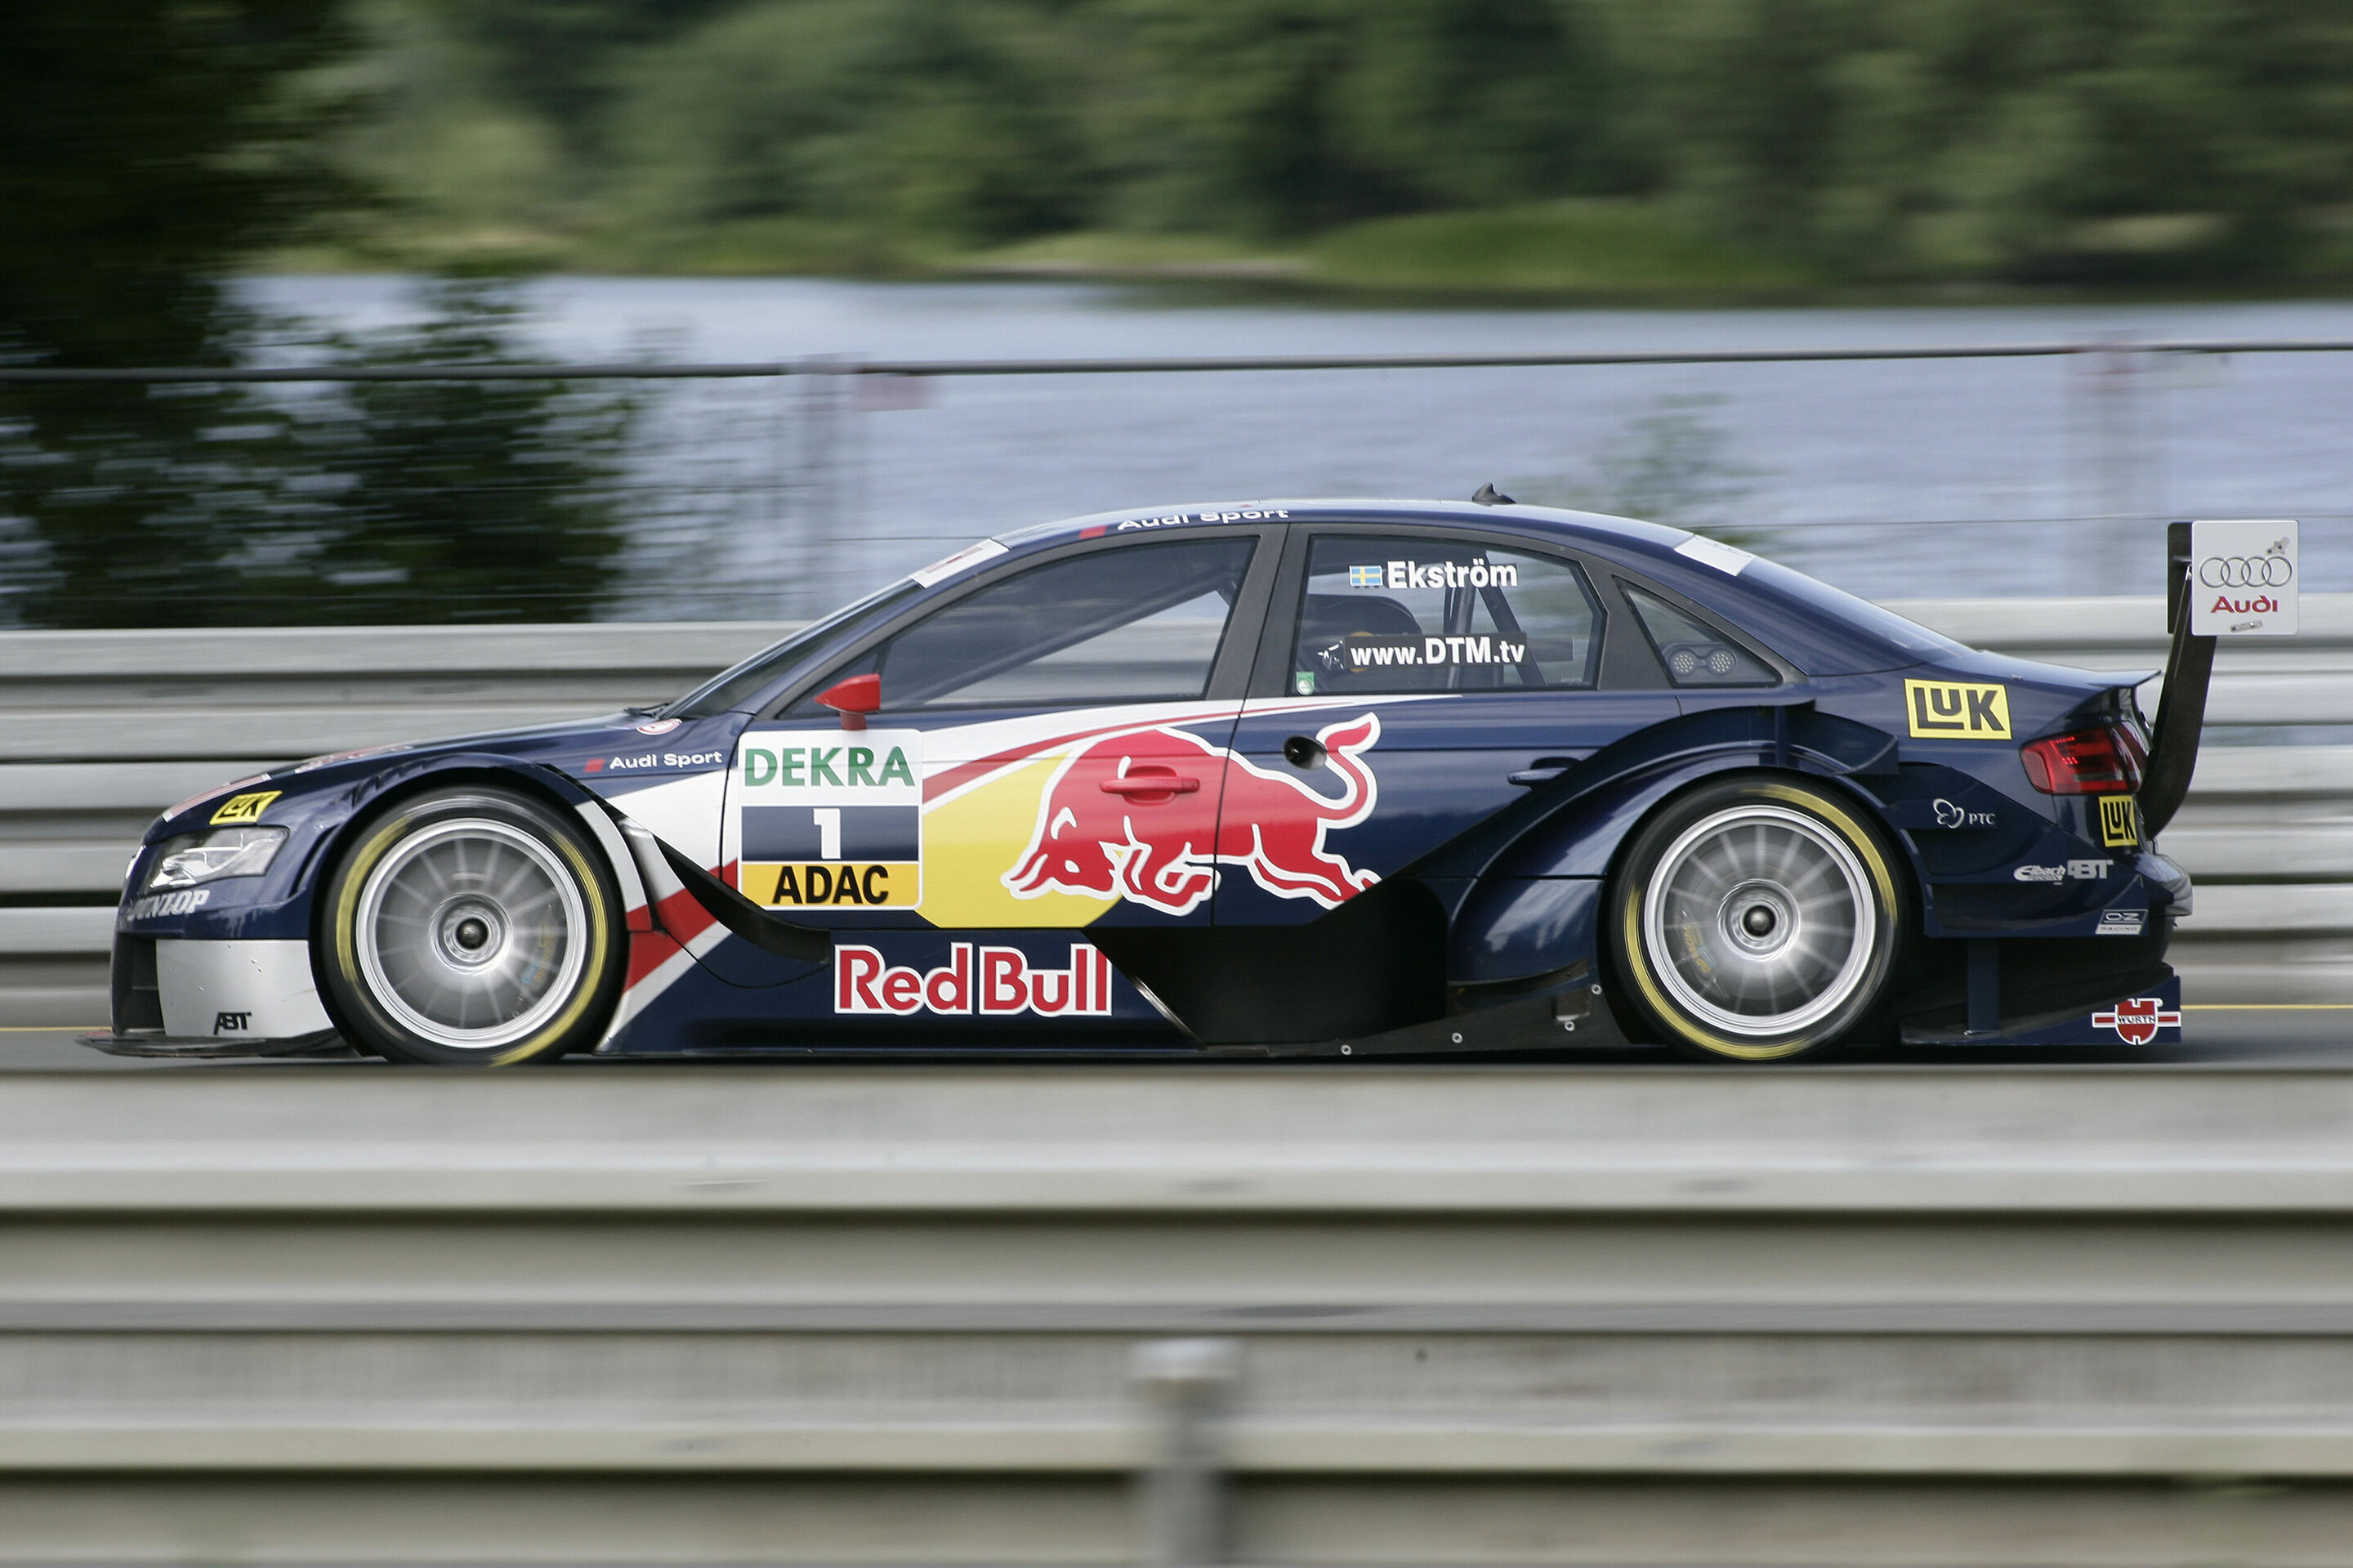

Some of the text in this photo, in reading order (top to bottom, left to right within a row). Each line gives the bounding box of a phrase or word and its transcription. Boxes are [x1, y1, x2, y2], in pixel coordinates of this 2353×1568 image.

[1117, 509, 1290, 531] Audi Sport
[1386, 558, 1518, 589] Ekström
[2210, 595, 2278, 614] Audi
[1350, 636, 1525, 666] www.DTM.tv
[609, 751, 723, 770] Audi Sport
[743, 746, 917, 788] DEKRA
[813, 807, 842, 860] 1
[1967, 813, 1996, 825] PTC
[771, 864, 890, 905] ADAC
[834, 942, 1113, 1016] Red Bull
[213, 1012, 252, 1036] ABT
